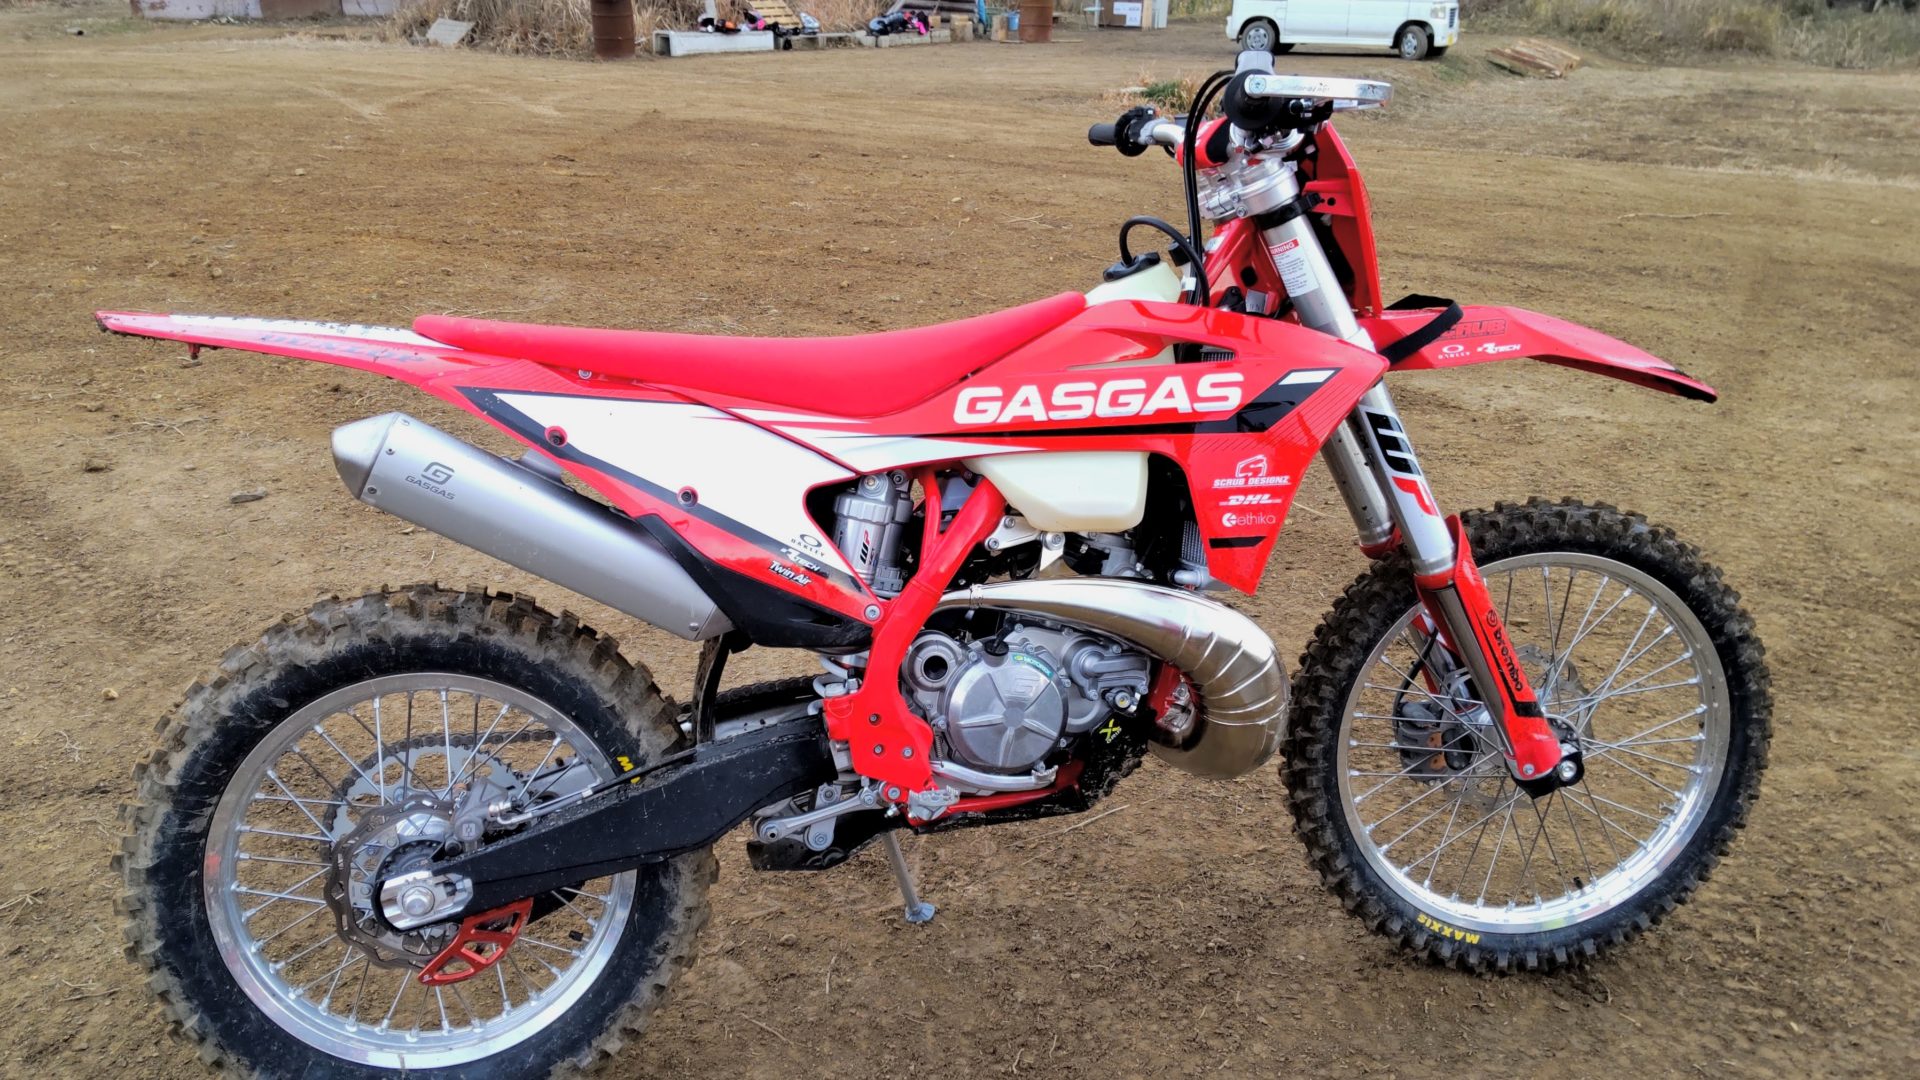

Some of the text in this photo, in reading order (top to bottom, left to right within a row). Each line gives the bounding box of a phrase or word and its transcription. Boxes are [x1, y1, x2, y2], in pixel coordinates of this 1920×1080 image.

[953, 372, 1244, 424] GASGAS
[1364, 411, 1440, 517] WP
[405, 475, 456, 500] GASGAS
[1213, 475, 1290, 488] SCRUB DESIGNZ
[1228, 494, 1272, 505] DHL
[1237, 512, 1277, 526] ethika
[791, 538, 825, 557] OAKLEY
[769, 560, 812, 587] Twin Air
[1494, 626, 1523, 692] brembo
[1417, 913, 1480, 945] MAXXIS
